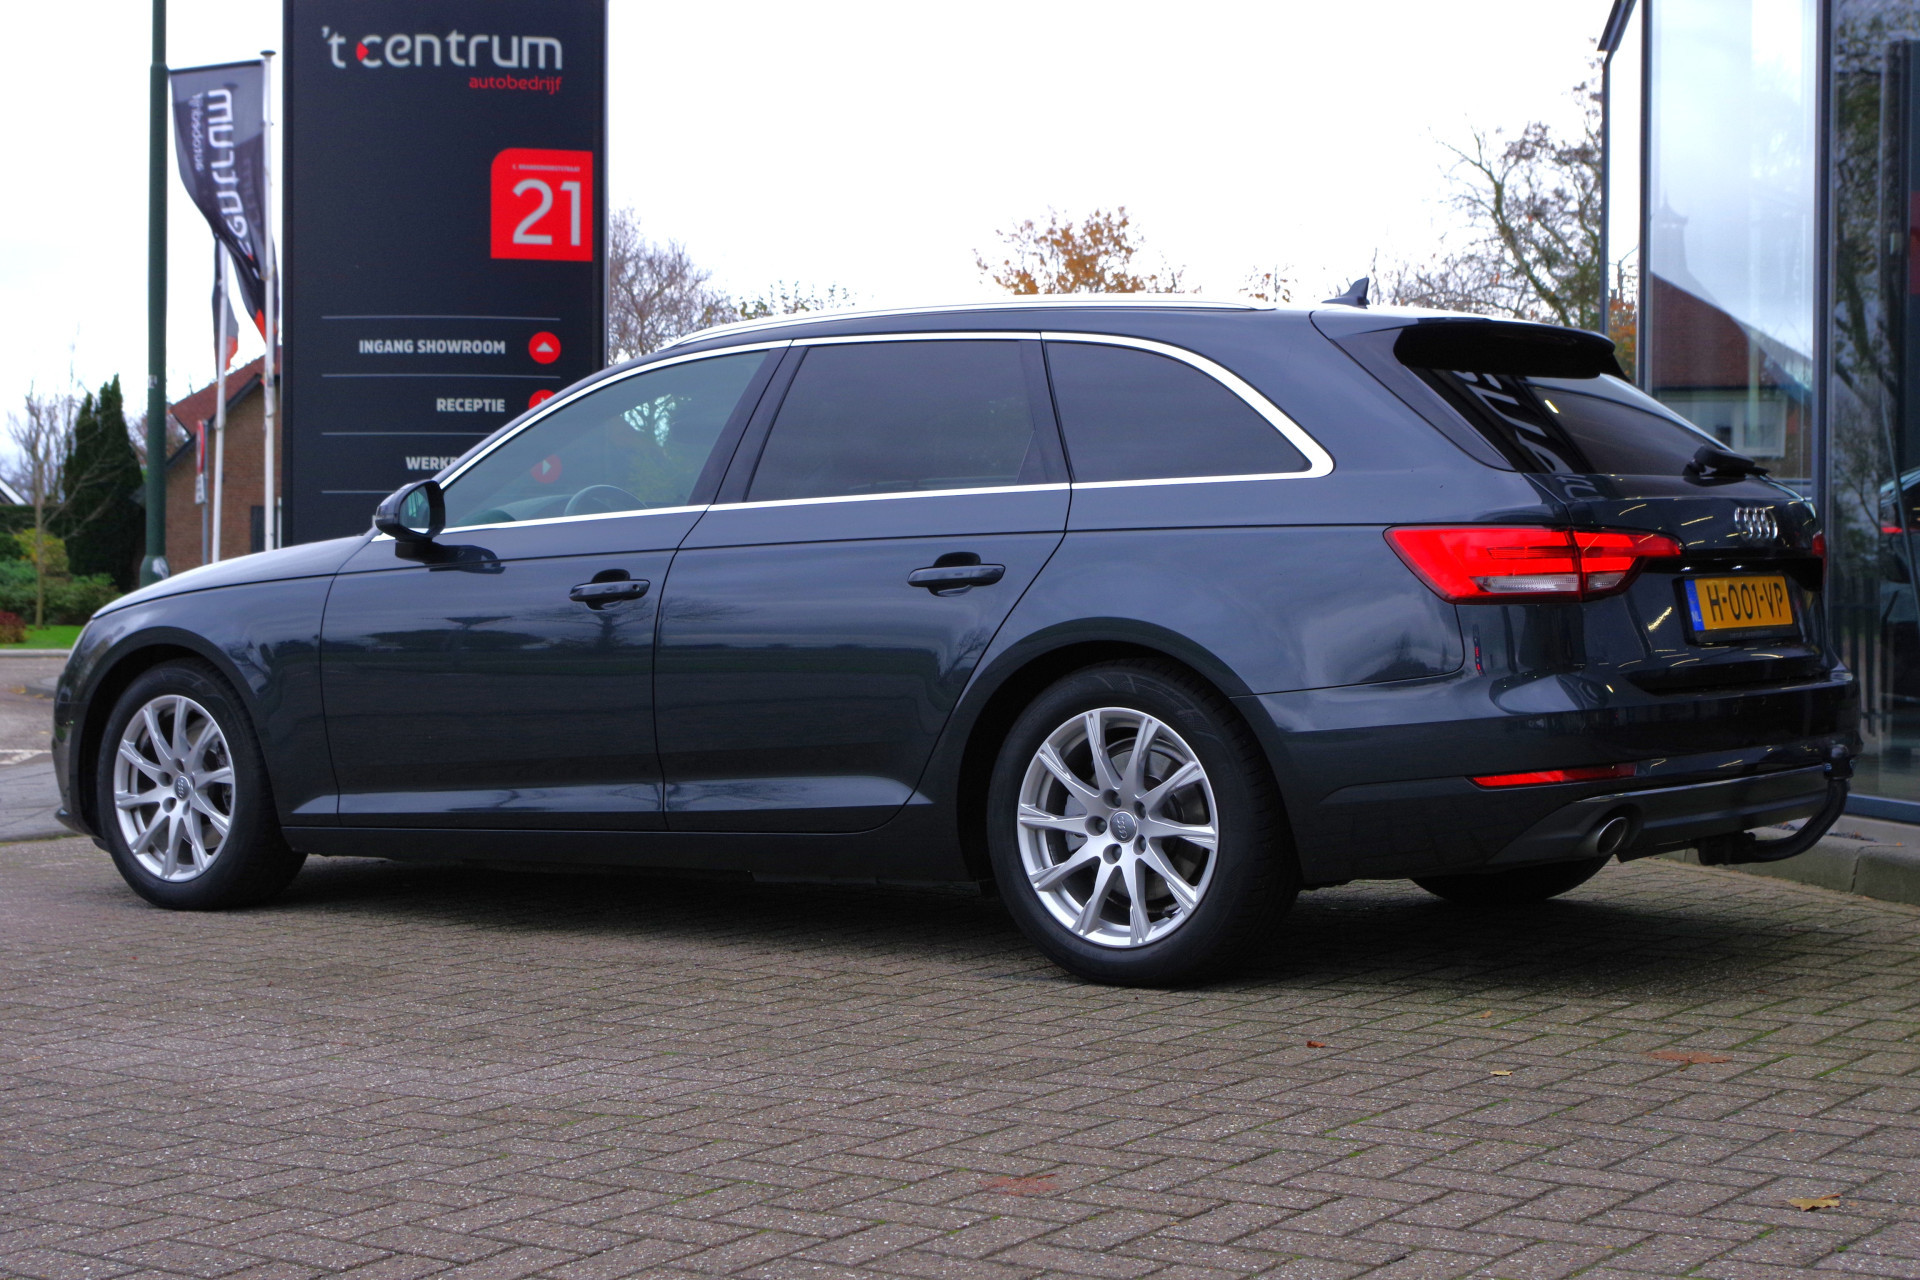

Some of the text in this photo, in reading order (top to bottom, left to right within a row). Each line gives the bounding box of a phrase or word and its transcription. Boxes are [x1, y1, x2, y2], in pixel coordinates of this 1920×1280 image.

[356, 29, 563, 70] centrum
[468, 74, 562, 95] autobedrijf
[512, 178, 581, 247] 21
[358, 339, 506, 354] INGANG SHOWROOM
[436, 398, 506, 413] RECEPTIE
[1706, 582, 1783, 622] H-001-VP
